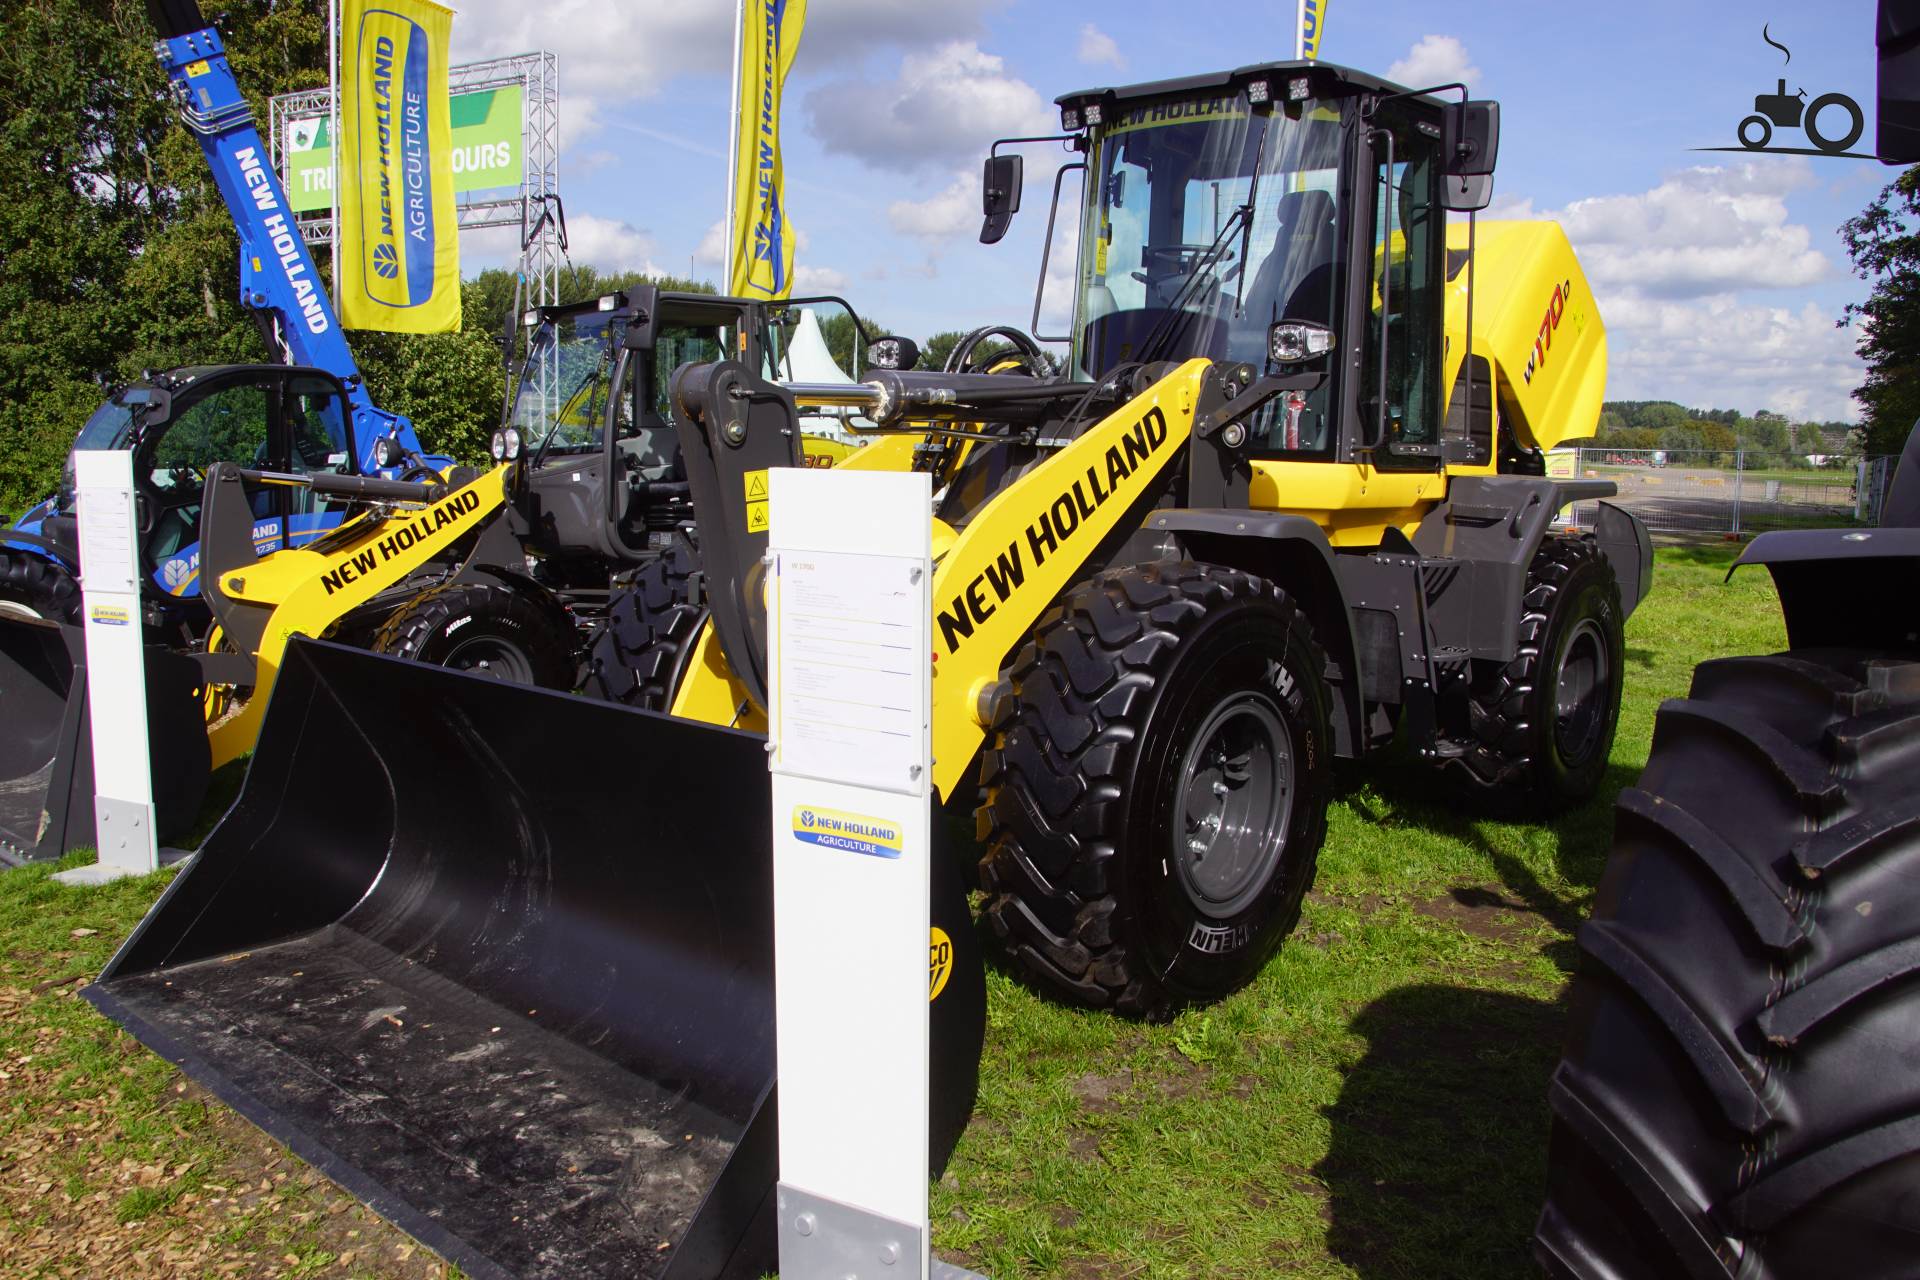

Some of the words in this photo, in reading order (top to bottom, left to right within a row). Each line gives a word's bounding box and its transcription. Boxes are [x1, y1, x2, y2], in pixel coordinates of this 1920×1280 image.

[374, 36, 394, 167] HOLLAND
[406, 91, 427, 242] AGRICULTURE
[451, 140, 511, 174] OURS
[376, 172, 394, 236] NEW
[235, 146, 279, 211] NEW
[263, 213, 329, 335] HOLLAND
[252, 523, 278, 541] AND
[256, 541, 277, 555] 1735
[320, 547, 377, 596] NEW
[377, 489, 480, 562] HOLLAND
[936, 540, 1025, 655] NEW
[1025, 405, 1168, 568] HOLLAND
[816, 834, 877, 854] AGRICULTURE
[817, 816, 842, 831] NEW
[844, 821, 896, 841] HOLLAND
[929, 941, 950, 968] CO
